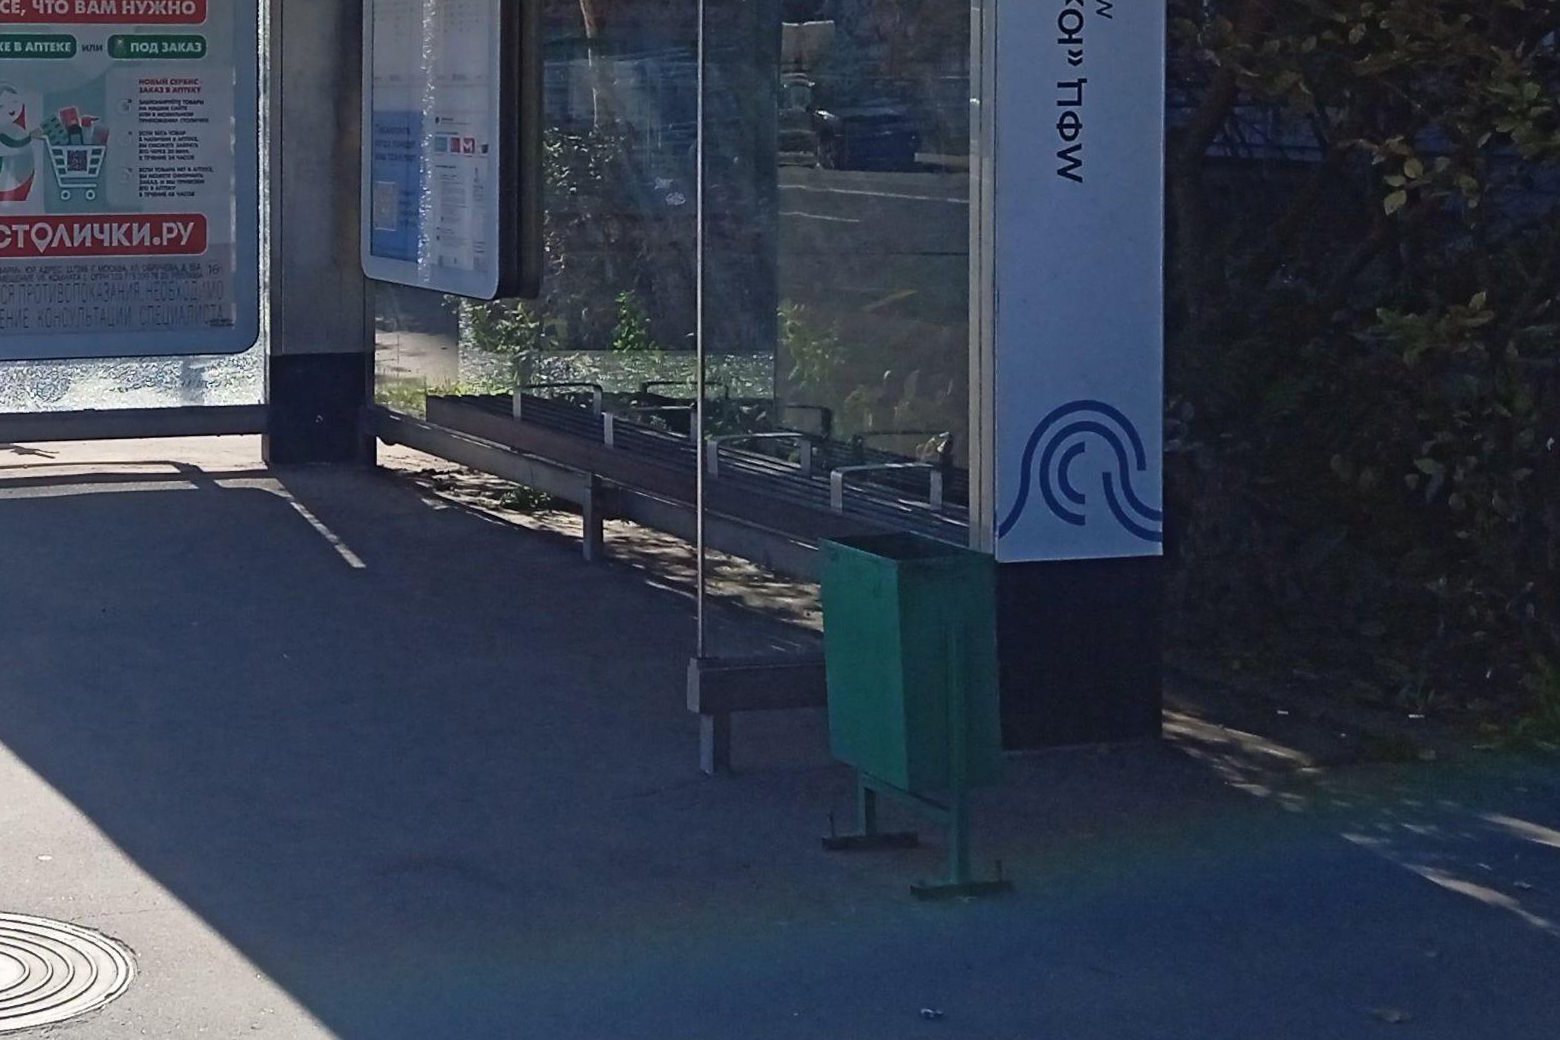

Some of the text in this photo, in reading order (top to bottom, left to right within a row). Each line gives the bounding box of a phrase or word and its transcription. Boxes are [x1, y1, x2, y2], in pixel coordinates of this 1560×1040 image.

[32, 0, 68, 15] ЧТО
[74, 0, 116, 15] ВАМ
[121, 0, 196, 15] НУЖНО
[14, 41, 22, 52] В
[24, 41, 71, 52] АПТЕКЕ
[130, 42, 202, 54] ПОД ЗАКАЗ
[1056, 78, 1087, 183] МФЦ
